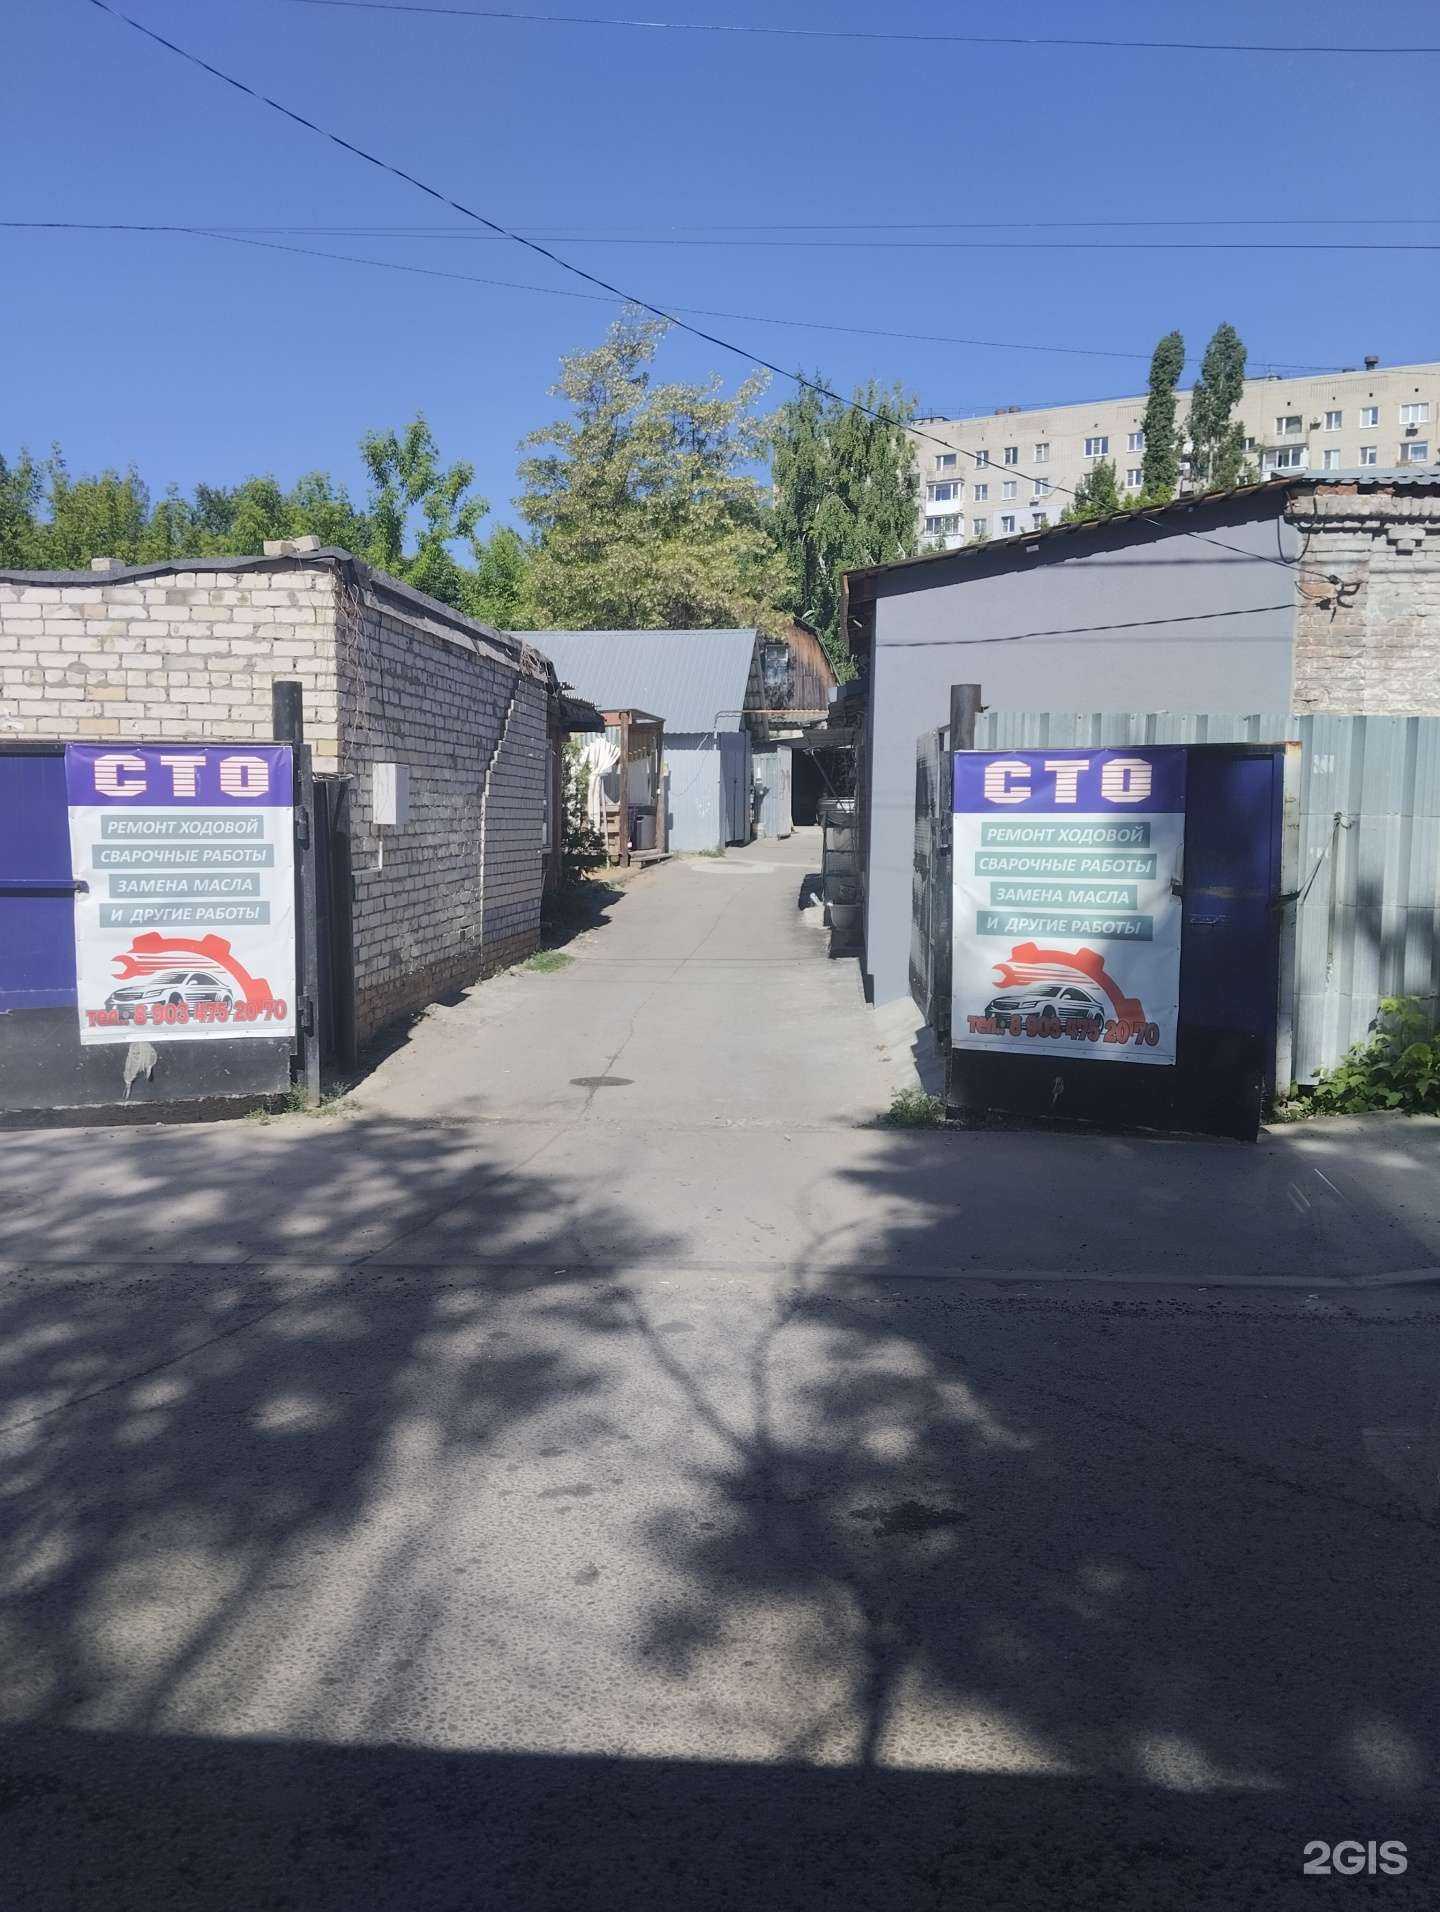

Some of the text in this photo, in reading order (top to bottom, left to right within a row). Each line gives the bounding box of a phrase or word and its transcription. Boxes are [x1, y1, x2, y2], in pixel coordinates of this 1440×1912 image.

[94, 754, 269, 797] СТО
[984, 758, 1153, 804] СТО
[107, 818, 258, 836] РЕМОНТ ХОДОВОЙ
[986, 825, 1144, 844] РЕМОНТ ХОДОВОЙ
[100, 848, 266, 863] СВАРОЧНЫЕ РАБОТЫ
[979, 857, 1152, 873] СВАРОЧНЫЕ РАБОТЫ
[117, 878, 253, 893] ЗАМЕНА МАСЛА
[996, 887, 1129, 904] ЗАМЕНА МАСЛА
[110, 906, 260, 923] И ДРУГИЕ РАБОТЫ
[986, 917, 1141, 935] И ДРУГИЕ РАБОТЫ
[133, 1004, 148, 1025] 8
[152, 1002, 189, 1025] 903
[1009, 1013, 1023, 1037] 8
